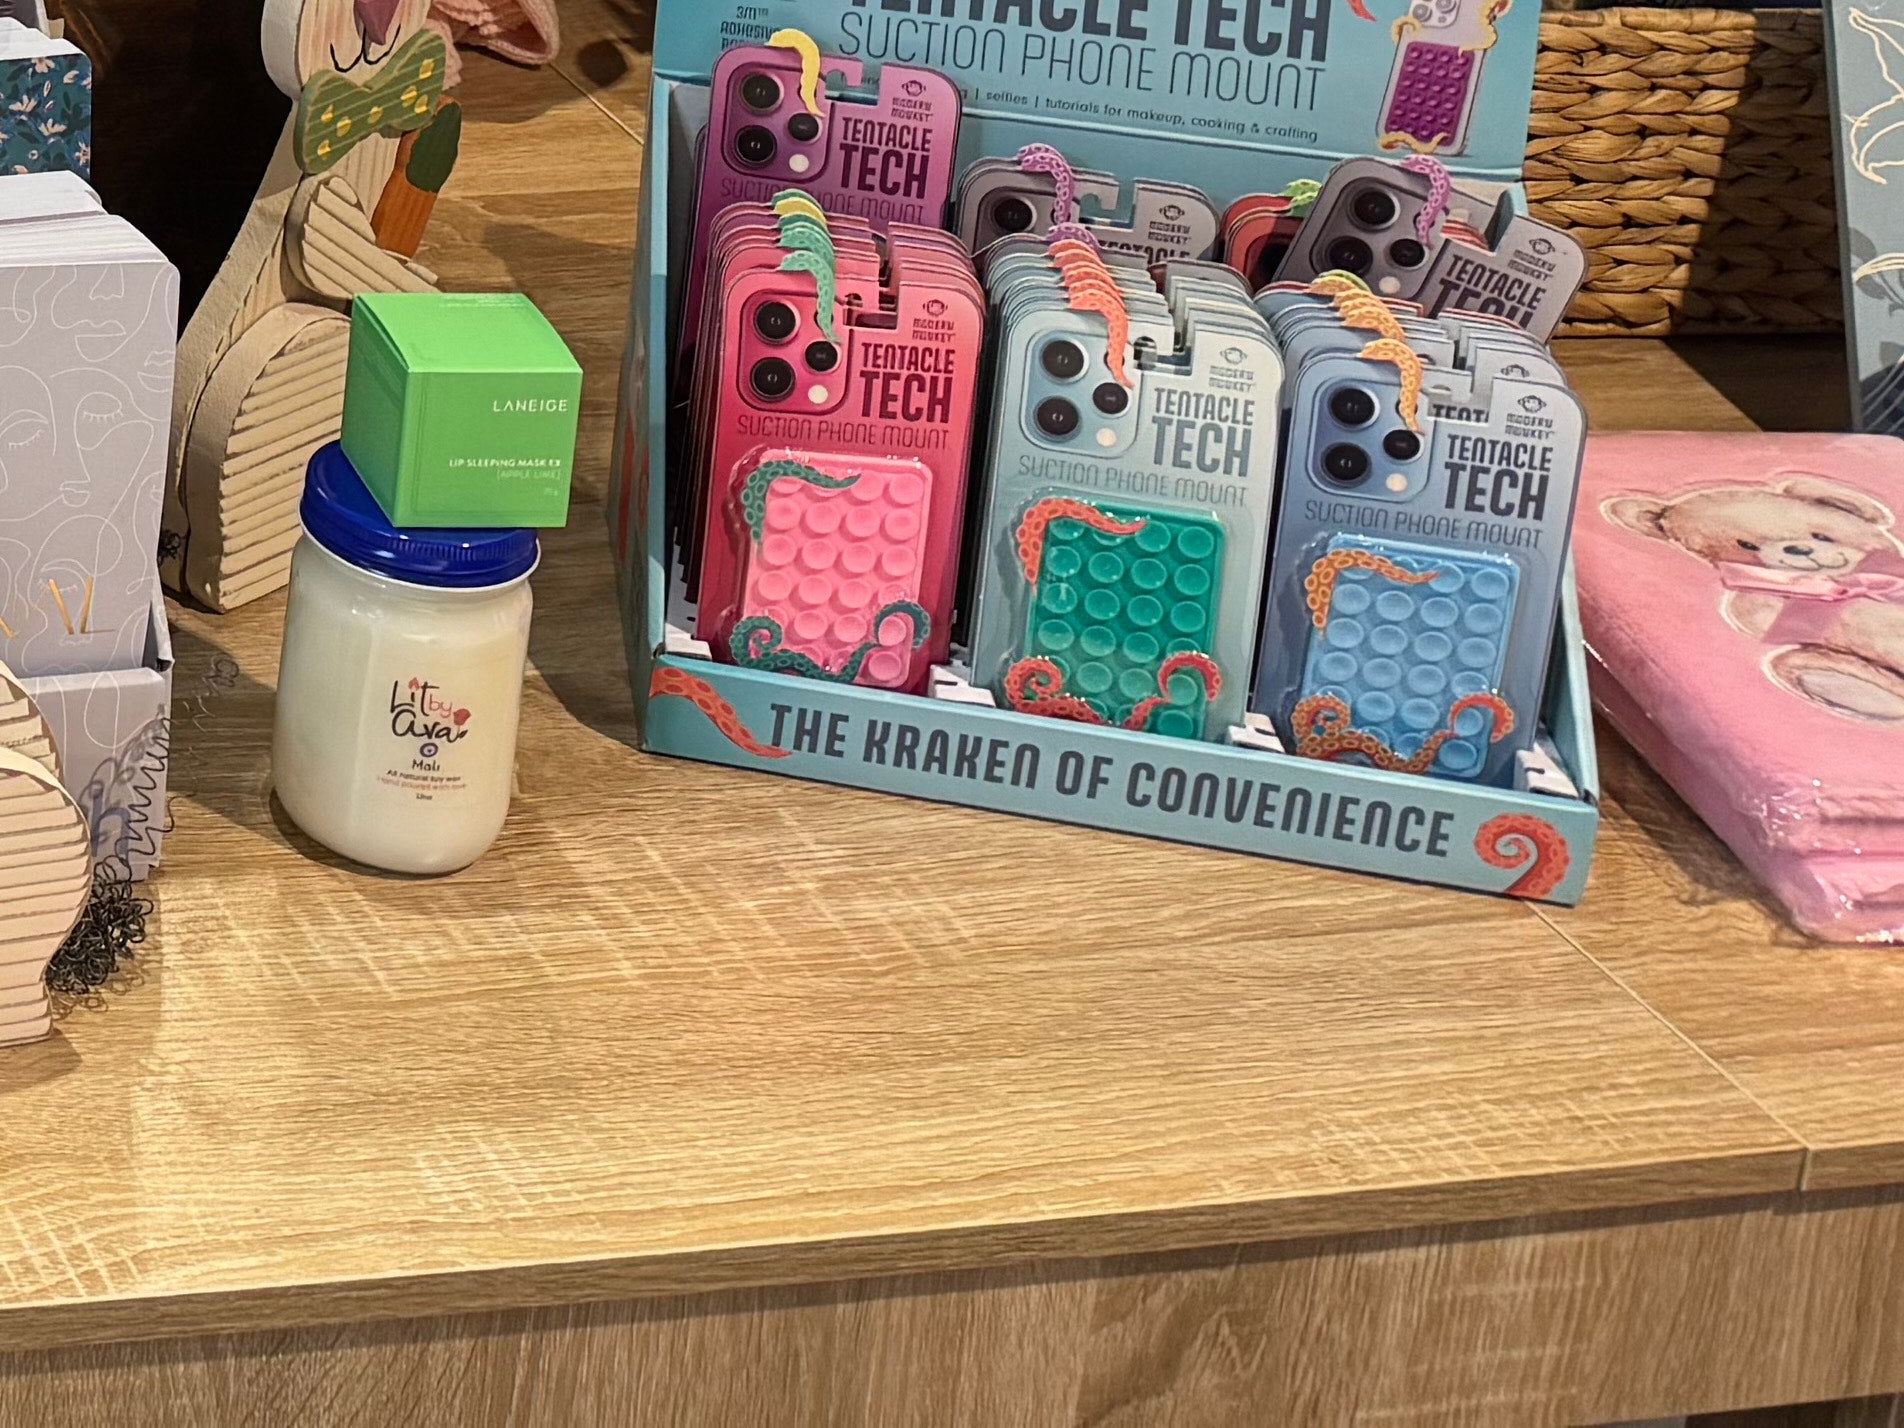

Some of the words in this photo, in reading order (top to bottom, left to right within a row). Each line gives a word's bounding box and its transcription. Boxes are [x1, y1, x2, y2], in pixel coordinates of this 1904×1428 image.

[838, 11, 1006, 72] SUCTION
[1022, 33, 1153, 92] PHONE
[1168, 51, 1326, 112] MOUNT
[842, 117, 933, 153] TENTACLE
[985, 87, 1028, 106] selfies
[1044, 96, 1099, 114] tutorials
[1102, 101, 1122, 117] for
[1126, 107, 1186, 128] makeup,
[1191, 114, 1246, 135] cooking
[1250, 121, 1261, 135] &
[1264, 125, 1319, 143] crafting
[839, 144, 929, 199] TECH
[860, 197, 924, 223] MOUNT
[1447, 254, 1548, 311] TENTACLE
[861, 342, 955, 374] TENTACLE
[492, 399, 567, 412] LANEIGE
[860, 372, 955, 423] TECH
[1154, 388, 1255, 425] TENTACLE
[736, 414, 812, 440] SUCTION
[816, 420, 876, 445] PHONE
[882, 424, 949, 450] MOUNT
[1152, 416, 1252, 477] TECH
[1447, 433, 1553, 471] TENTACLE
[1019, 455, 1098, 489] SUCTION
[1106, 468, 1167, 497] PHONE
[1174, 477, 1249, 507] MOUNT
[1444, 461, 1548, 521] TECH
[1304, 500, 1388, 529] SUCTION
[1395, 512, 1460, 538] PHONE
[1467, 519, 1542, 548] MOUNT
[428, 694, 453, 718] by
[769, 704, 848, 757] THE
[863, 718, 1038, 788] KRAKEN
[1056, 750, 1112, 799] OF
[1125, 762, 1454, 857] CONVENIENCE
